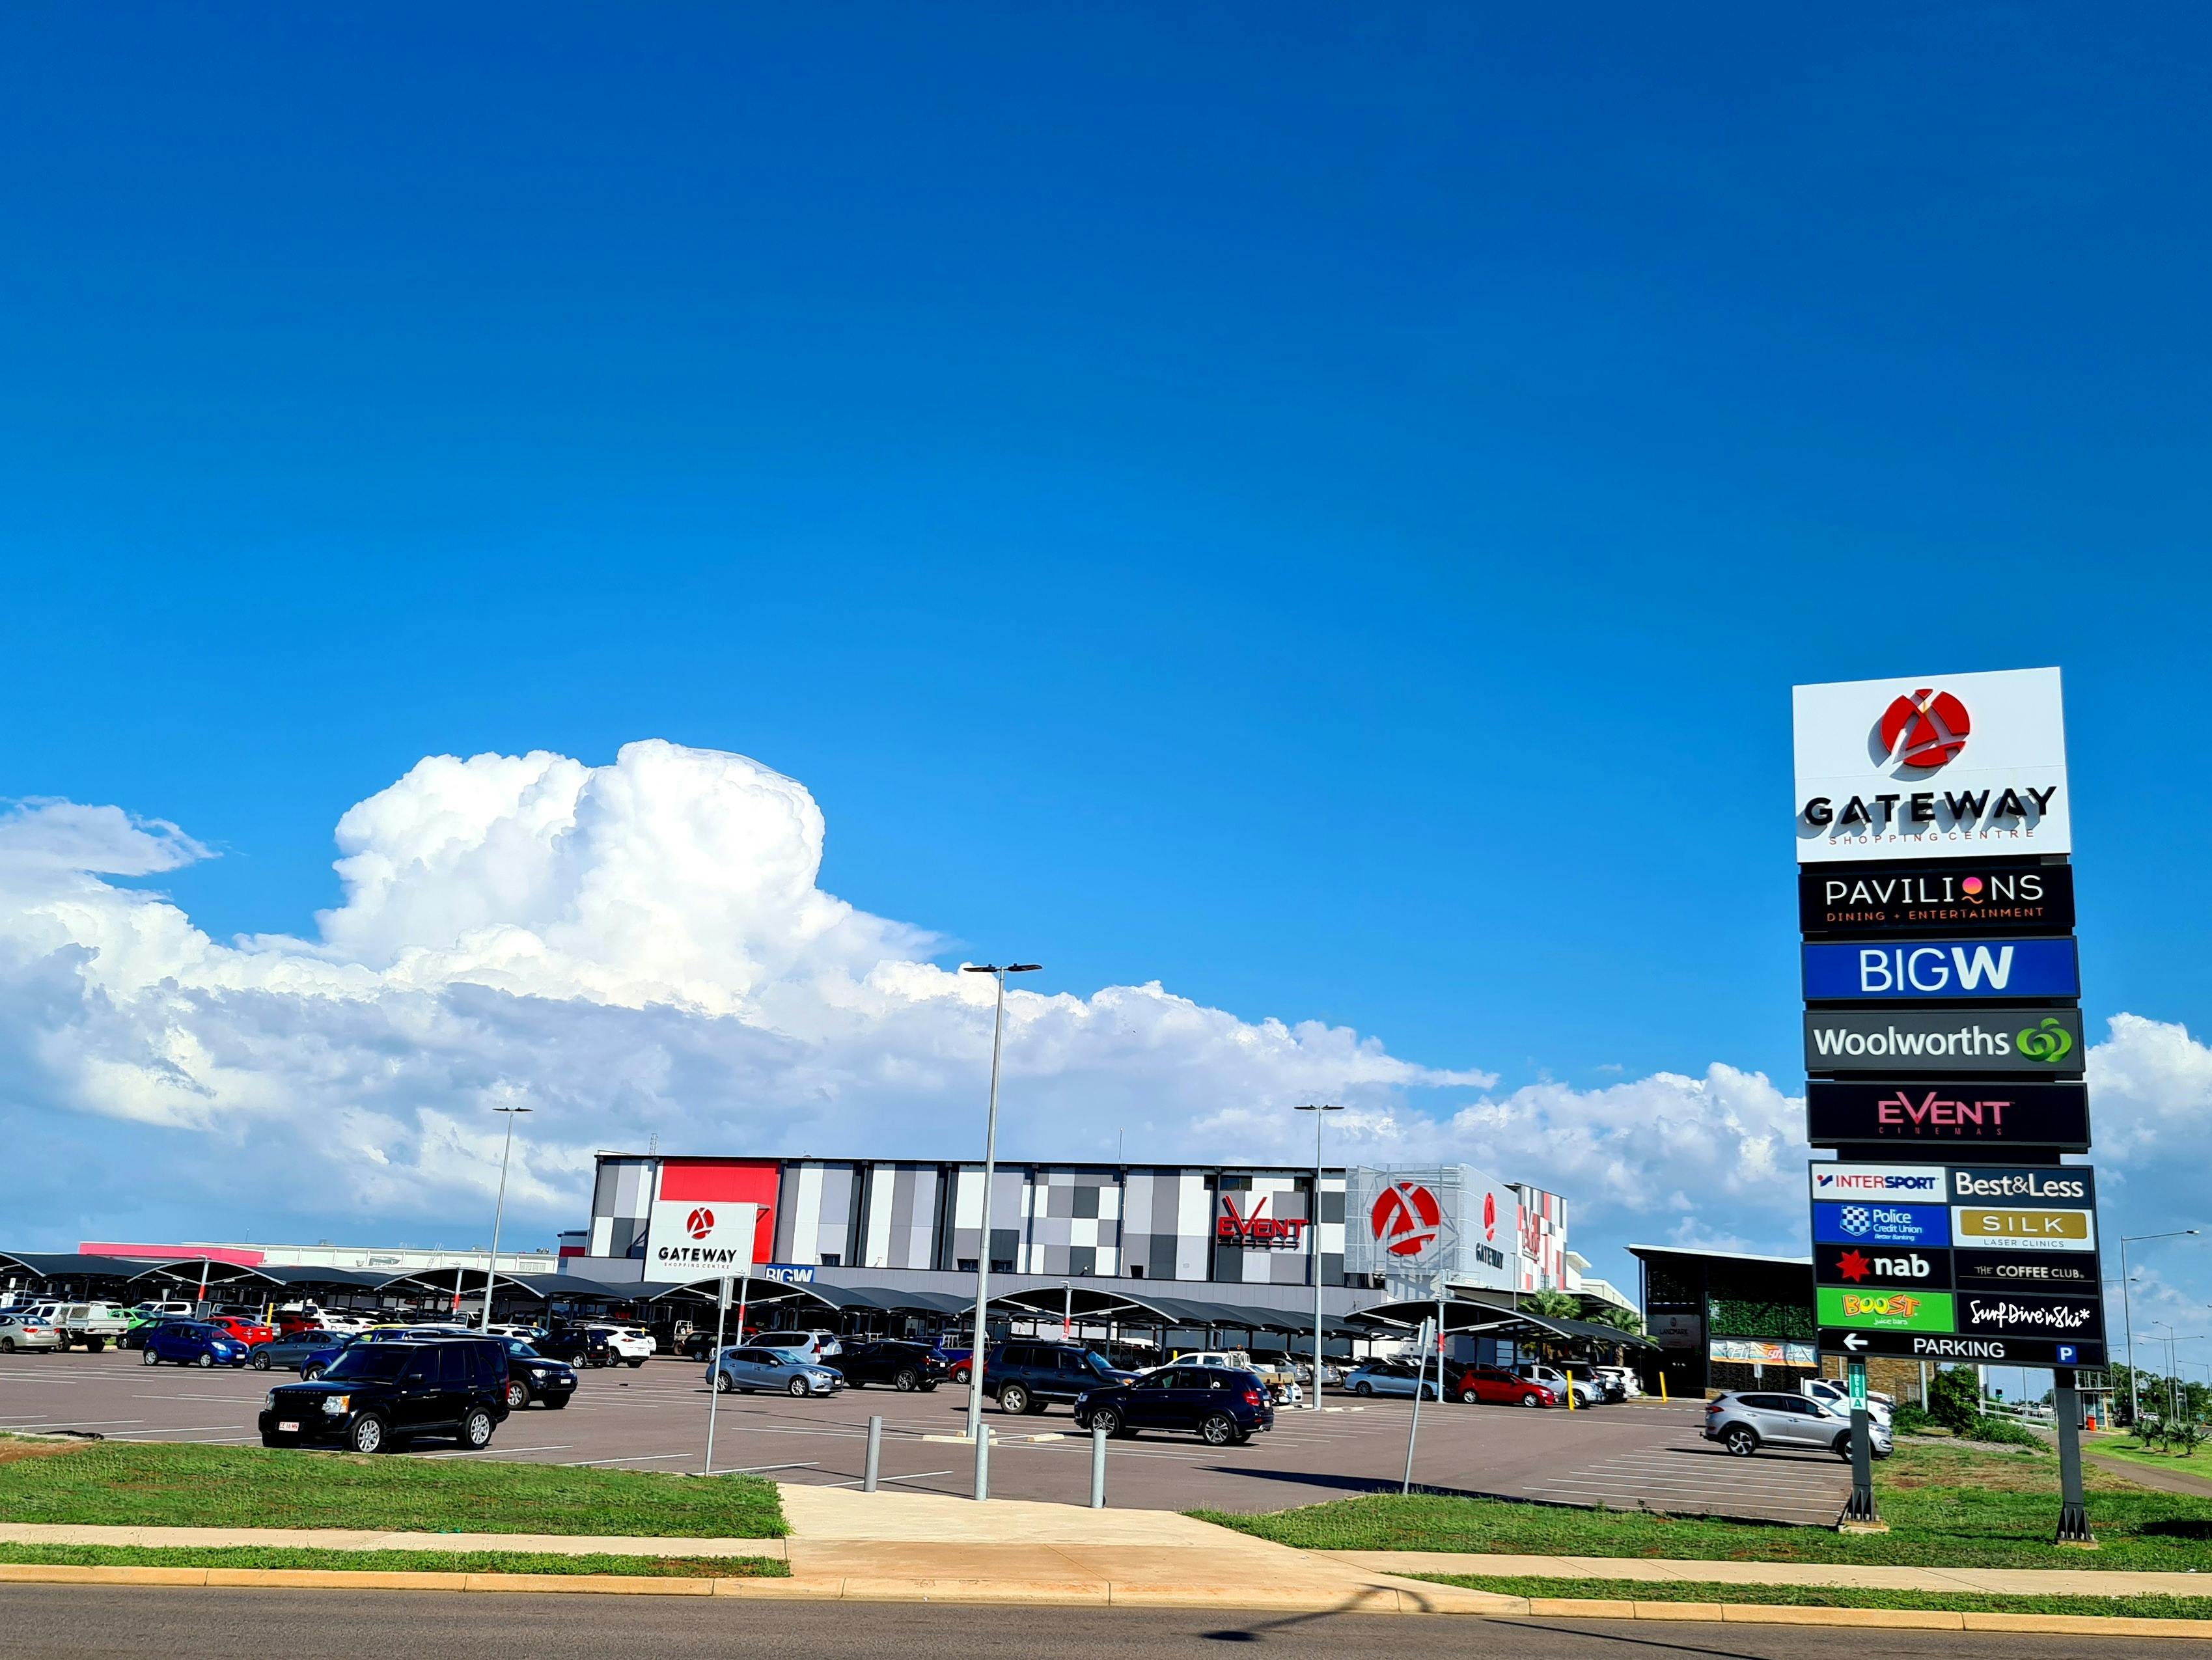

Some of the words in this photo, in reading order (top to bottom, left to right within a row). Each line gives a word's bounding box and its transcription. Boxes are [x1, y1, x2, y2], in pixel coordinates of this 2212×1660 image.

[1804, 786, 2057, 825] GATEWAY
[1829, 832, 1939, 846] SHOPPING
[1948, 829, 2034, 841] CENTRE
[1825, 874, 2044, 906] PAVILIONS
[1826, 911, 1885, 922] DINING
[1908, 907, 2044, 920] ENTERTAINMENT
[1813, 1025, 2010, 1056] Woolworths
[1879, 1126, 2002, 1136] CINEMAS
[1836, 1174, 1936, 1190] INTERSPORT
[1956, 1172, 2084, 1198] Best&Less
[1873, 1208, 1911, 1224] Police
[1982, 1215, 2064, 1234] SILK
[1873, 1224, 1898, 1232] Credit
[1899, 1224, 1922, 1233] Union
[2022, 1239, 2064, 1248] CLINICS
[658, 1246, 738, 1264] GATEWAY
[1475, 1241, 1504, 1270] GATEWAY
[1873, 1254, 1929, 1277] nab
[1974, 1266, 1994, 1275] THE
[1996, 1265, 2049, 1279] COFFEE
[1842, 1294, 1921, 1318] BOOST
[1913, 1337, 2005, 1359] PARKING
[2060, 1348, 2073, 1361] P
